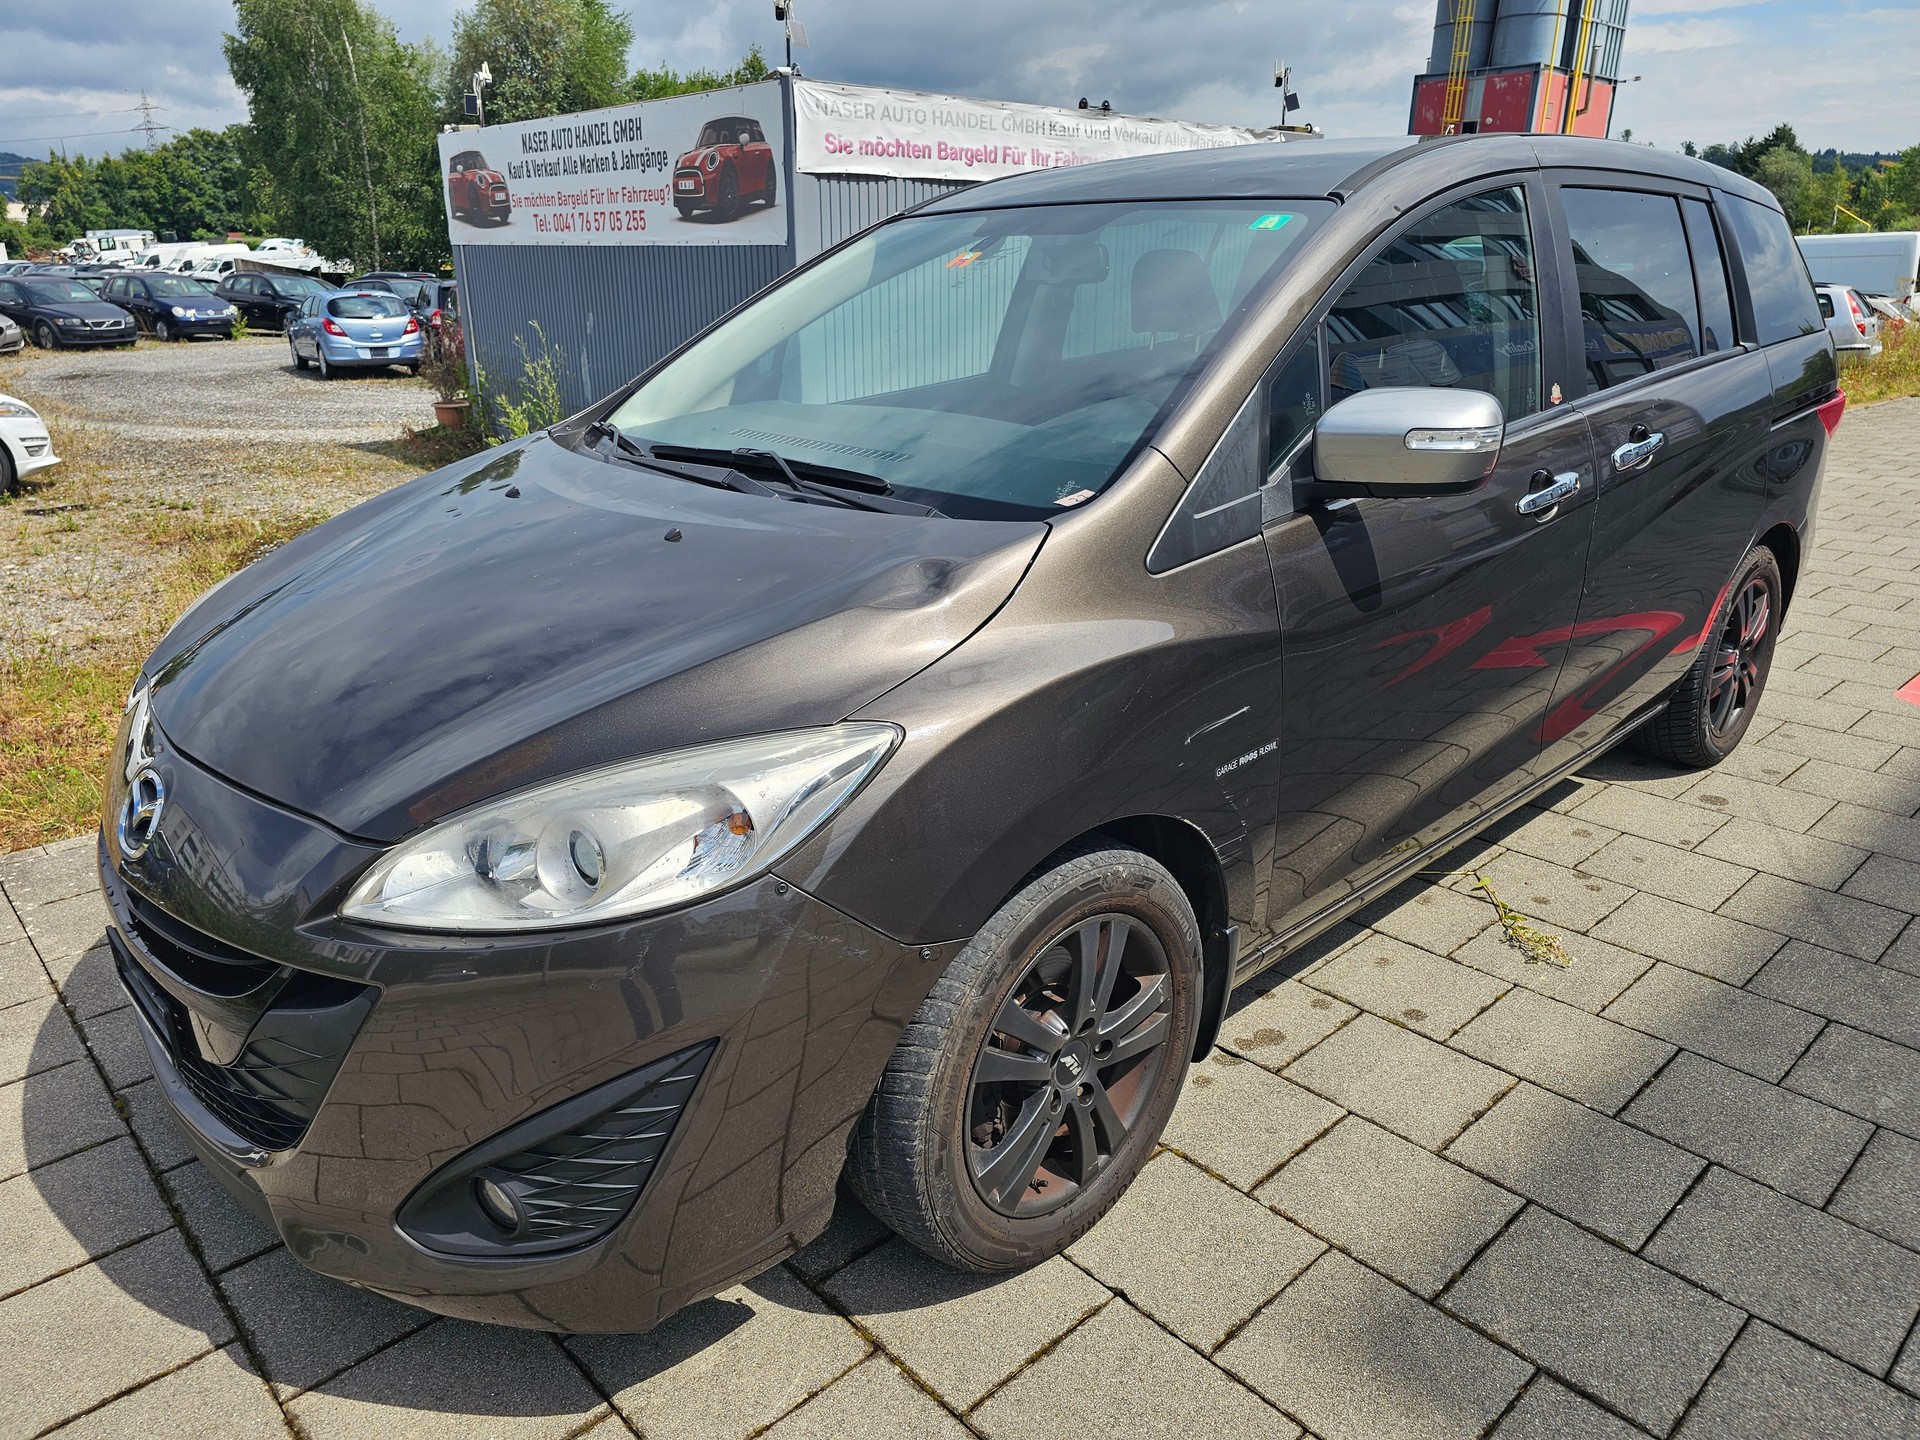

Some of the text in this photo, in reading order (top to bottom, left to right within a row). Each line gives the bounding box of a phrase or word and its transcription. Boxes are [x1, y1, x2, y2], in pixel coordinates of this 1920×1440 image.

[521, 117, 643, 154] NASER AUTO HANDEL GMBH
[815, 99, 876, 121] NASER
[880, 104, 928, 125] AUTO
[932, 109, 997, 131] HANDEL
[1001, 116, 1046, 135] GMBH
[1049, 119, 1080, 138] Kauf
[1084, 123, 1111, 141] Und
[1114, 126, 1162, 146] Verkauf
[1164, 132, 1187, 148] Alle
[507, 147, 669, 180] Kauf & Verkauf Alle Marken & Jahrgänge
[824, 132, 853, 155] Sie
[858, 135, 932, 160] möchten
[937, 140, 998, 167] Bargeld
[1002, 145, 1027, 166] Für
[1031, 148, 1050, 167] Ihr
[511, 193, 523, 208] Sie
[524, 192, 556, 208] möchten
[557, 189, 589, 210] Bargeld
[590, 188, 605, 205] Für
[606, 187, 620, 204] Ihr
[621, 183, 671, 206] Fahrzeug?
[533, 209, 647, 233] Tel: 0041 76 57 05 255
[1216, 759, 1238, 778] GARAGE
[1239, 749, 1258, 767] ROOS
